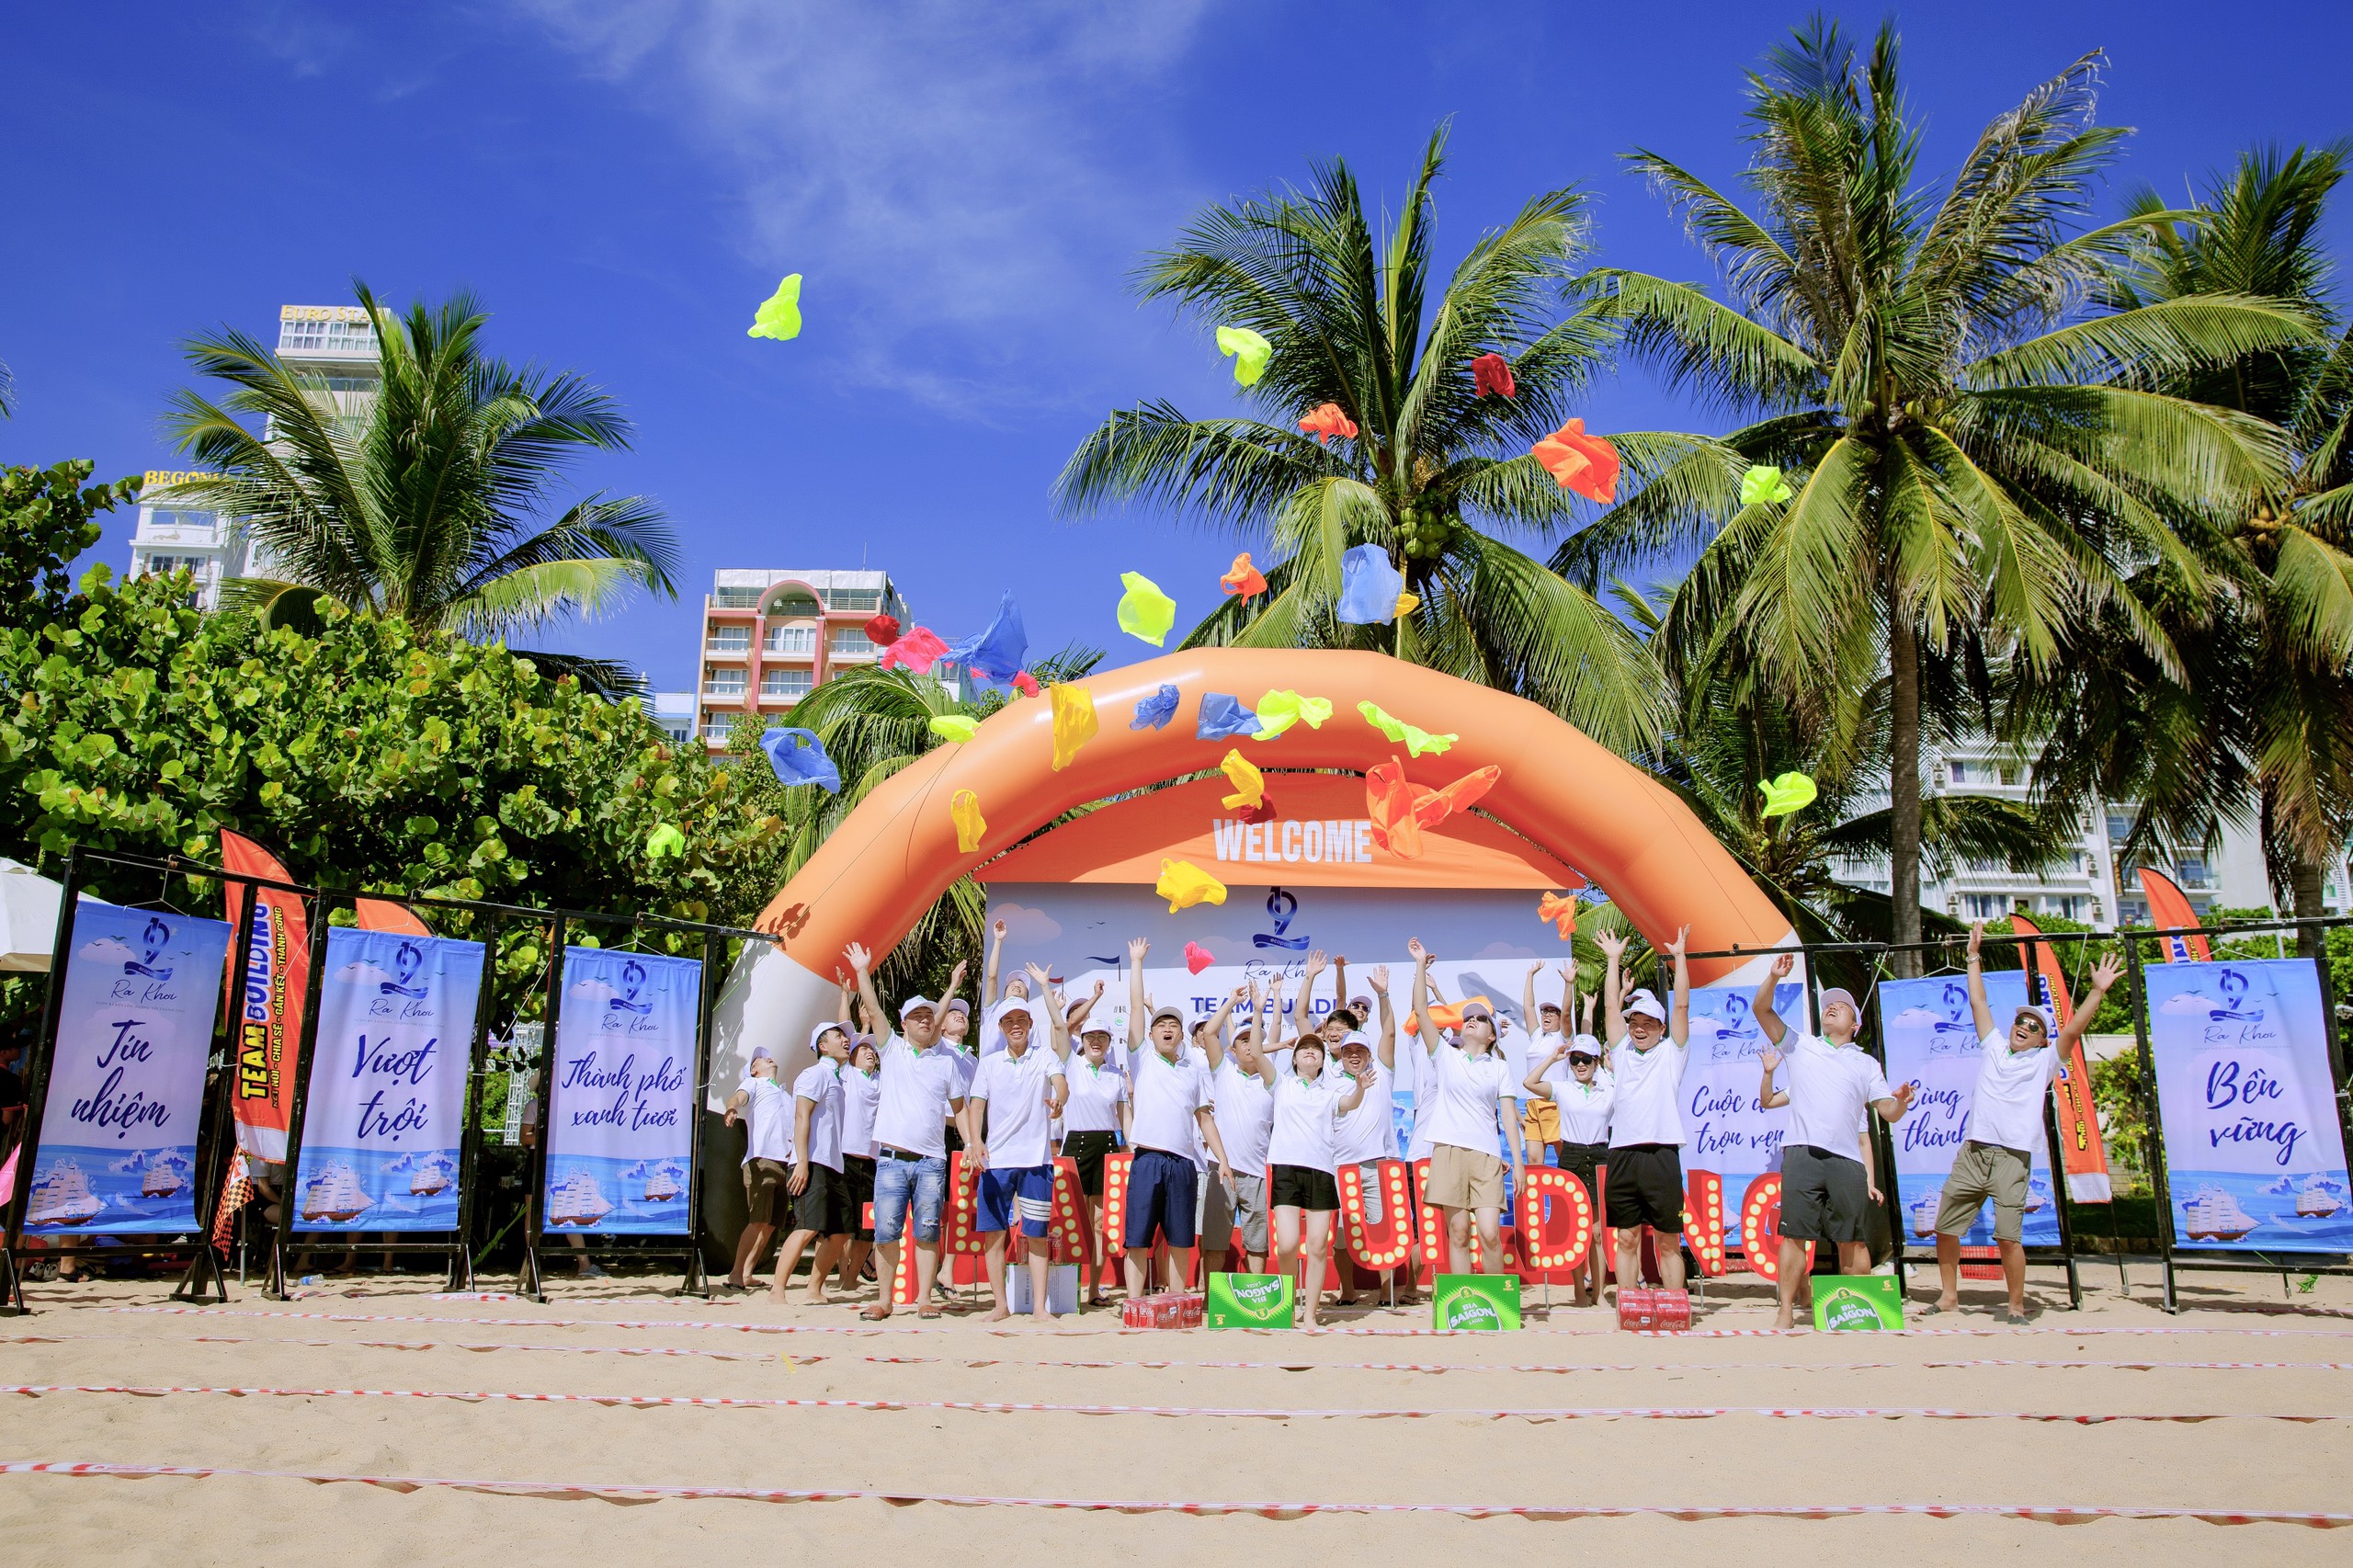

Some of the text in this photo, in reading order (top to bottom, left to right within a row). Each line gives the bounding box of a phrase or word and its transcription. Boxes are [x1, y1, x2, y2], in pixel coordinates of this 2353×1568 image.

[335, 306, 382, 322] STA
[1212, 818, 1373, 864] WELCOME
[1244, 959, 1272, 980] Ra
[97, 1019, 153, 1069] Tín
[240, 1023, 269, 1100] TEAM
[272, 1038, 283, 1062] CHIA
[351, 1034, 438, 1085] Vượt
[561, 1051, 688, 1103] Thành phố
[2206, 1061, 2284, 1109] Bền
[71, 1065, 172, 1140] nhiệm
[358, 1090, 429, 1142] trội
[571, 1090, 678, 1132] xanh tươi
[1691, 1085, 1746, 1119] Cuộc
[1695, 1121, 1785, 1155] trọn vẹn
[2209, 1116, 2308, 1166] vững
[1461, 1302, 1478, 1312] BIA
[1840, 1302, 1858, 1312] BIA
